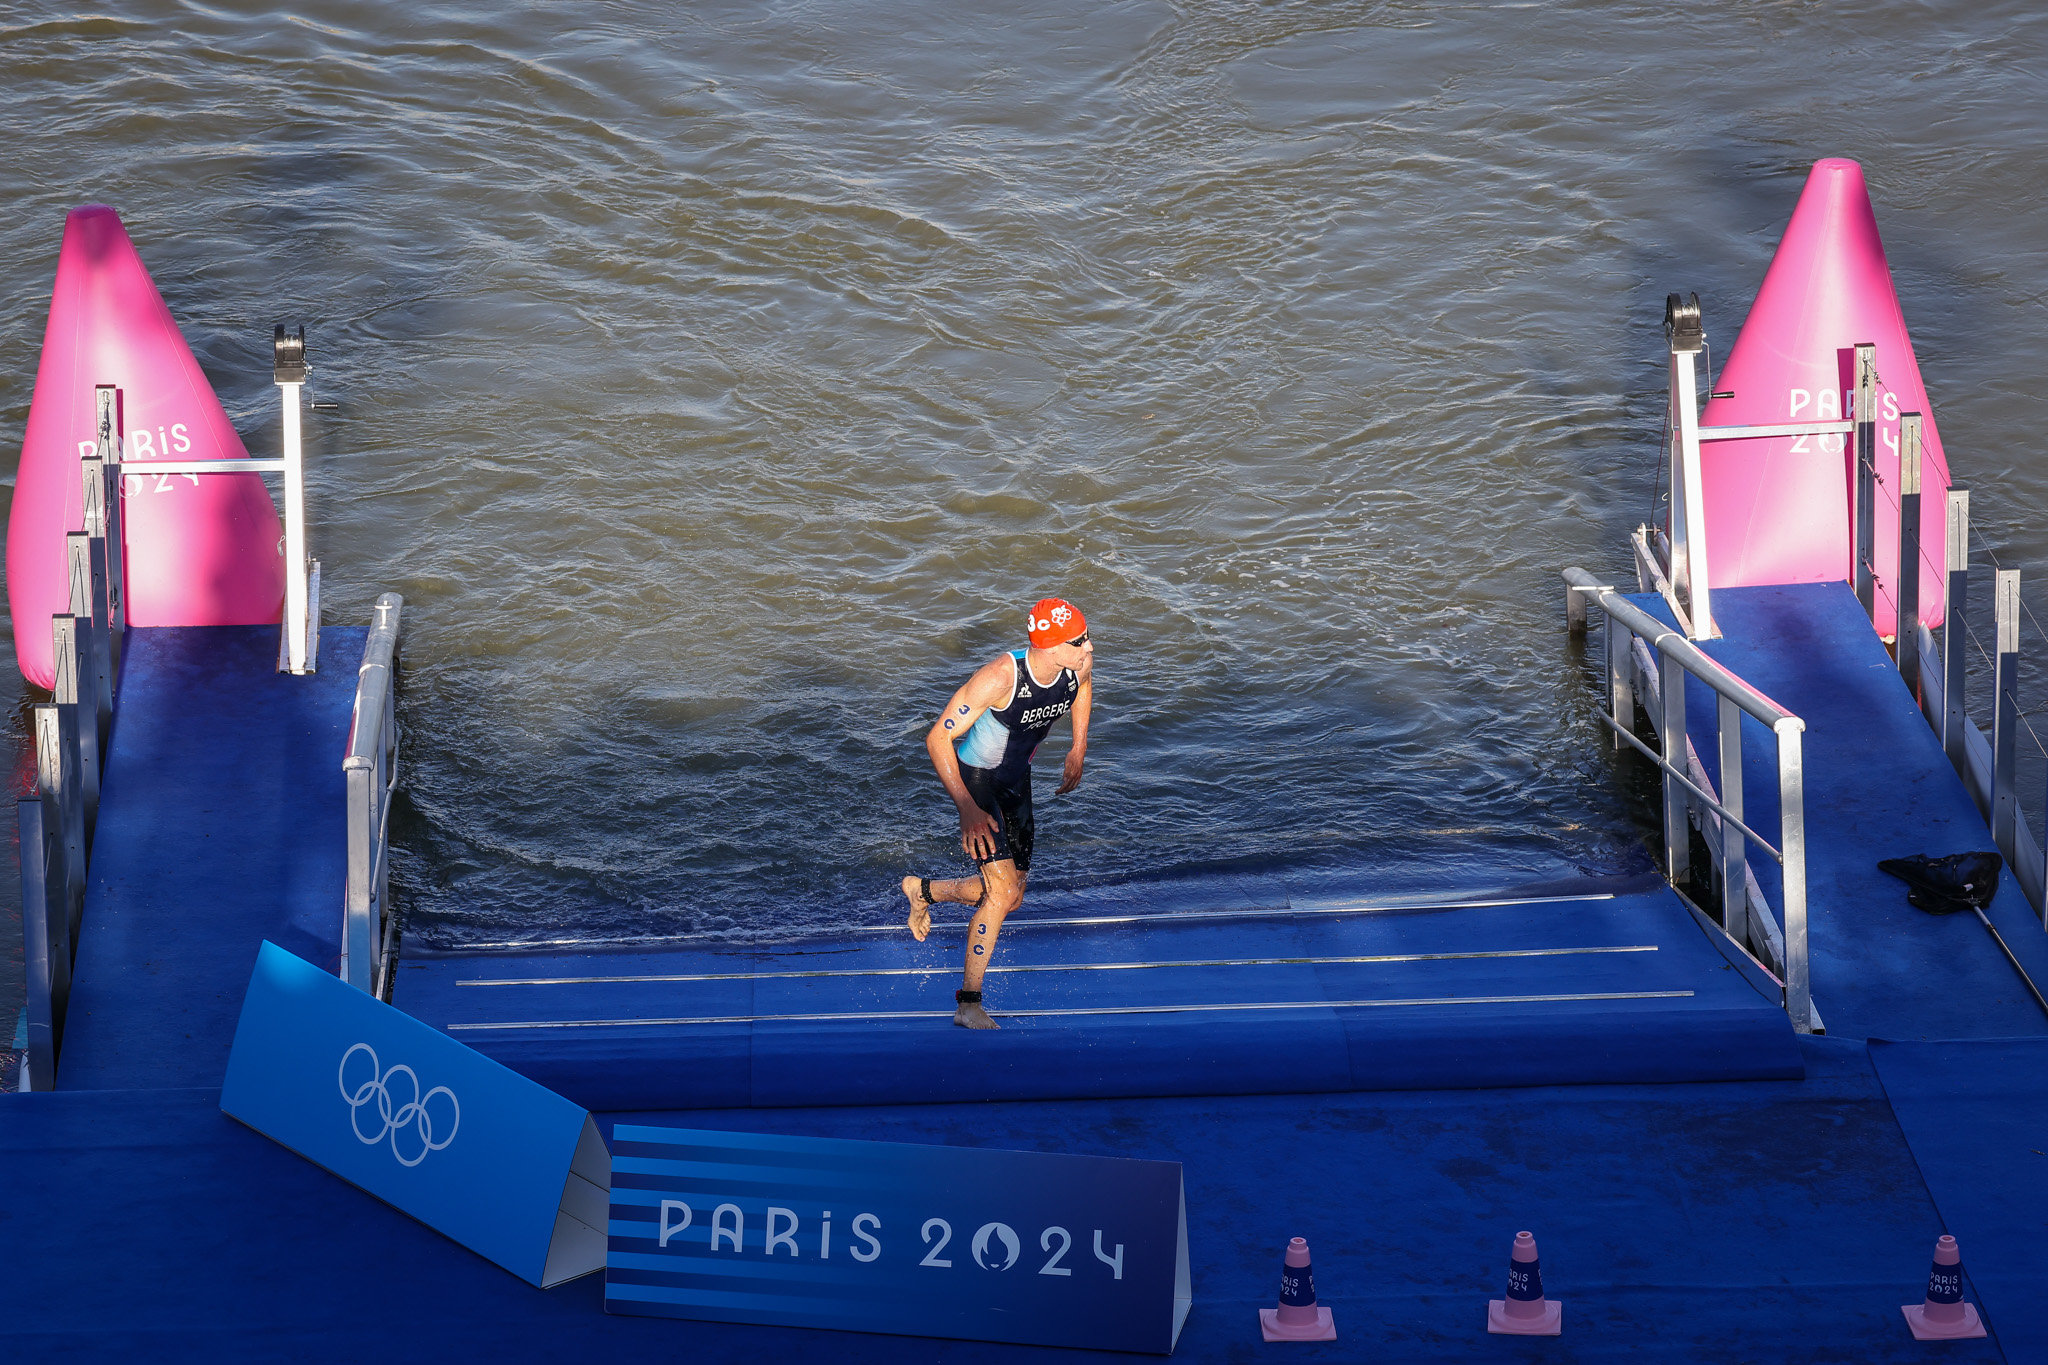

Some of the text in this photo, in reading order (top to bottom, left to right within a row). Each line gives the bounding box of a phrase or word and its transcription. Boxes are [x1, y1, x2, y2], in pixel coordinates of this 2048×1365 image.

[1789, 427, 1899, 457] 204
[958, 704, 971, 715] 3
[1020, 700, 1071, 724] BERGERE
[977, 923, 987, 935] 3
[918, 1217, 1124, 1280] 2024
